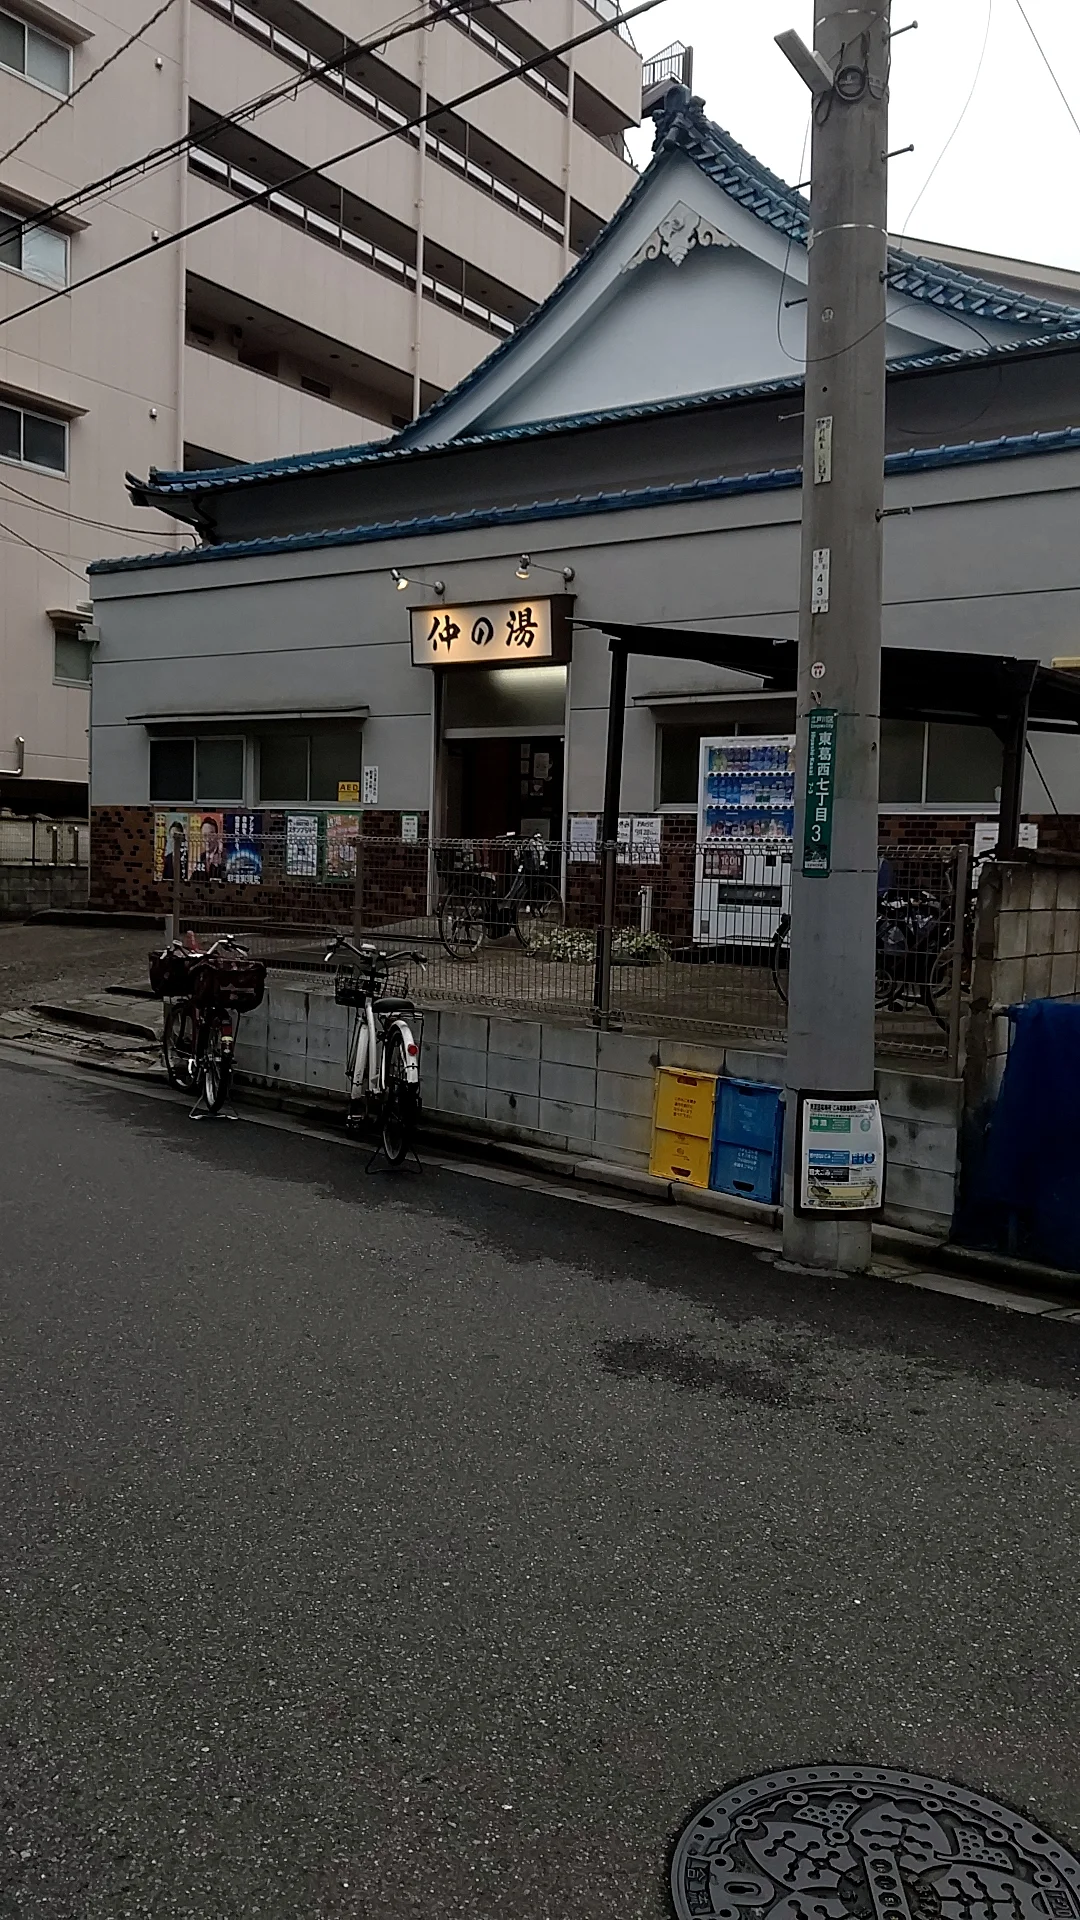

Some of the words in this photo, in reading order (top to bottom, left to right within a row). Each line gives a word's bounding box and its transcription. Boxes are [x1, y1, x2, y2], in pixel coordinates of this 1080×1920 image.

[427, 606, 538, 653] 仲の湯
[340, 783, 359, 791] AED
